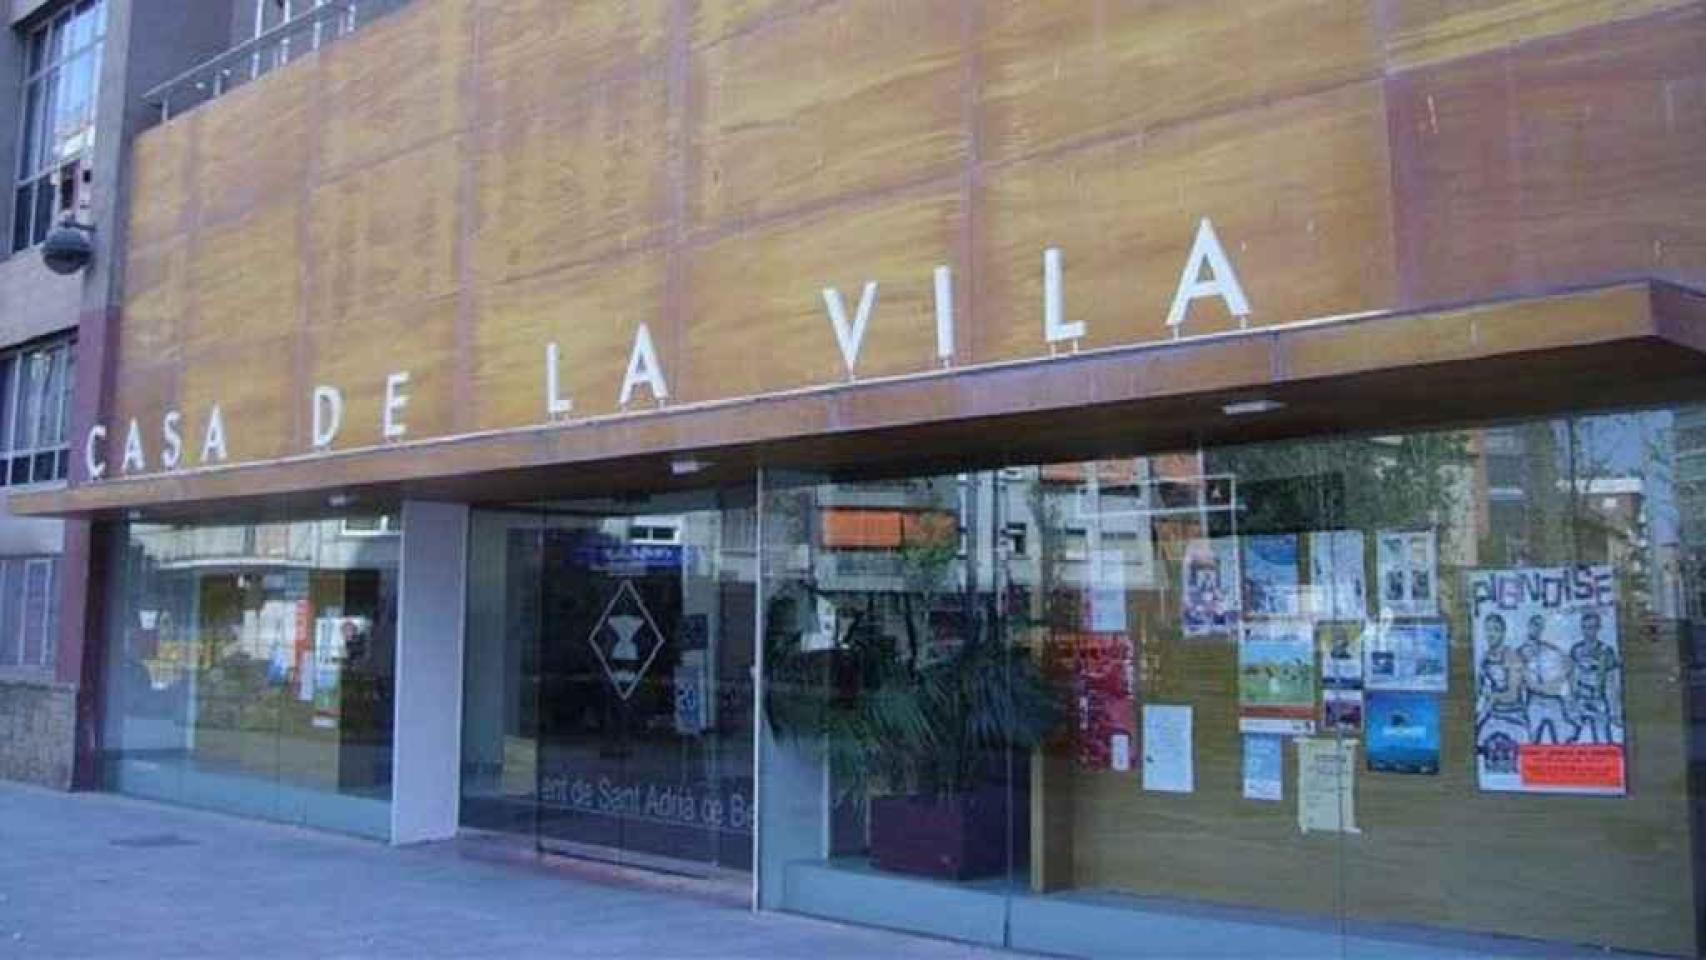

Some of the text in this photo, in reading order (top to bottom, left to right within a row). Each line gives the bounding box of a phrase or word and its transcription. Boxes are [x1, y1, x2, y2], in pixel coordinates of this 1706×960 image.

[85, 217, 1250, 479] CASA DE LA VILA
[598, 777, 640, 814] Sant
